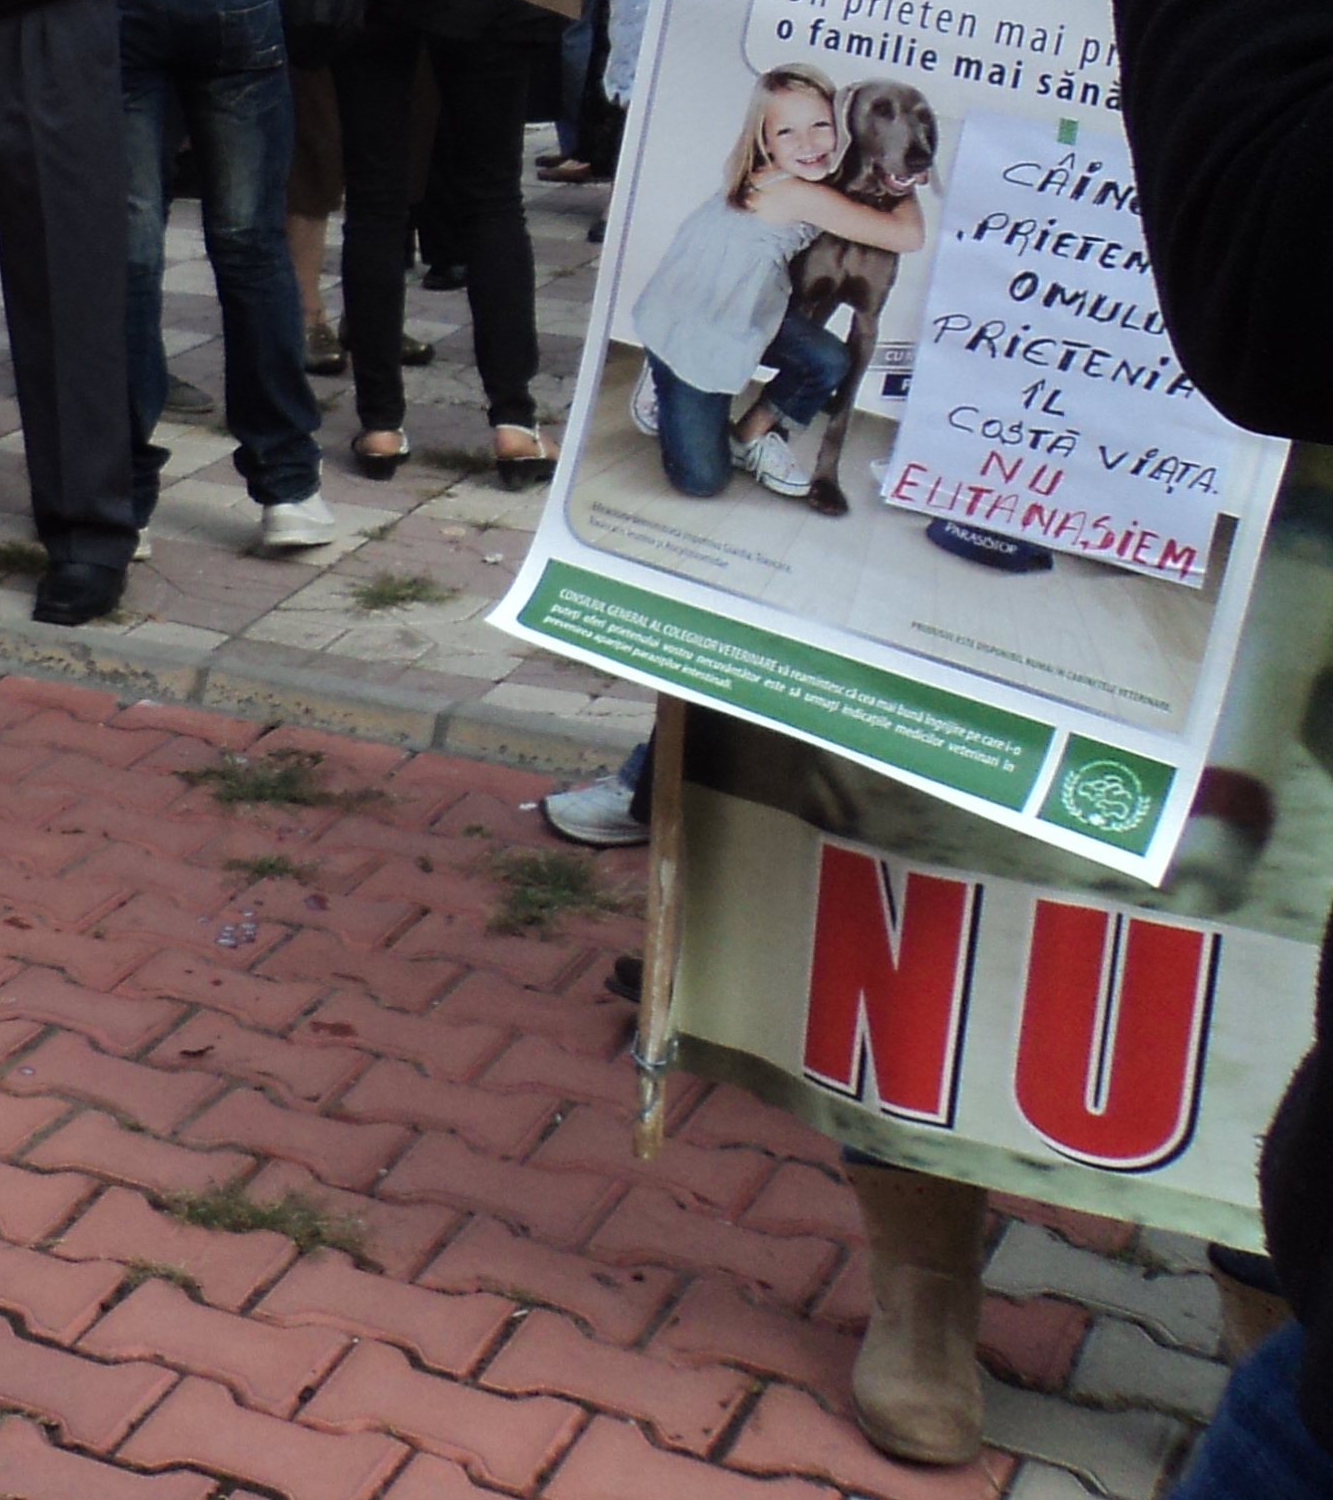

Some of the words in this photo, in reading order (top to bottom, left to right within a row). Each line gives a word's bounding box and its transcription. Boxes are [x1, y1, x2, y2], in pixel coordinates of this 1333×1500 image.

[776, 18, 795, 41] o
[808, 17, 940, 73] familie
[953, 52, 1026, 91] mai
[993, 18, 1067, 59] mai
[981, 450, 1067, 496] NU
[889, 461, 1198, 580] EUTANASIEM
[803, 838, 1223, 1175] NU
